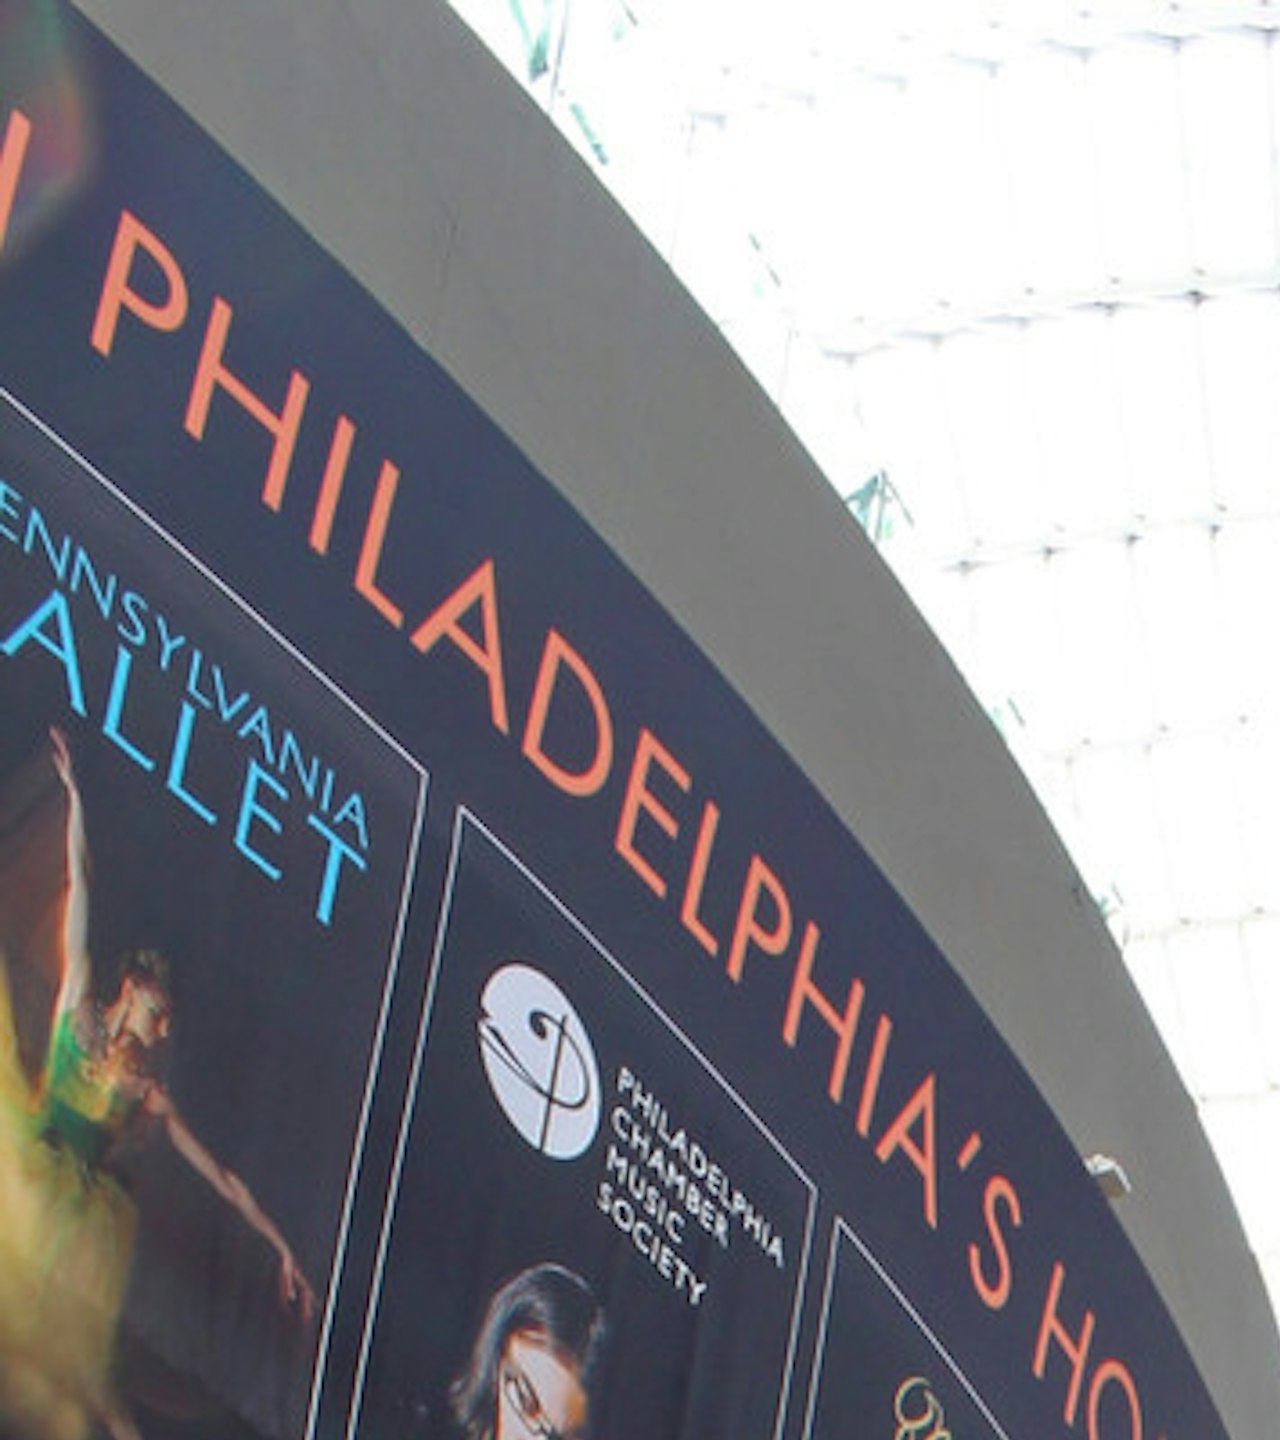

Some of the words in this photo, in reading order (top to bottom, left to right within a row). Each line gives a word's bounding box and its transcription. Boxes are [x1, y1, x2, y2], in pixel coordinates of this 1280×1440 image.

[90, 209, 1021, 1308] PHILADELPHIA'S
[606, 1144, 686, 1244] MUSIC
[611, 1106, 730, 1249] CHAMBER
[616, 1066, 785, 1269] PHILADELPHIA
[597, 1181, 707, 1306] SOCIETY
